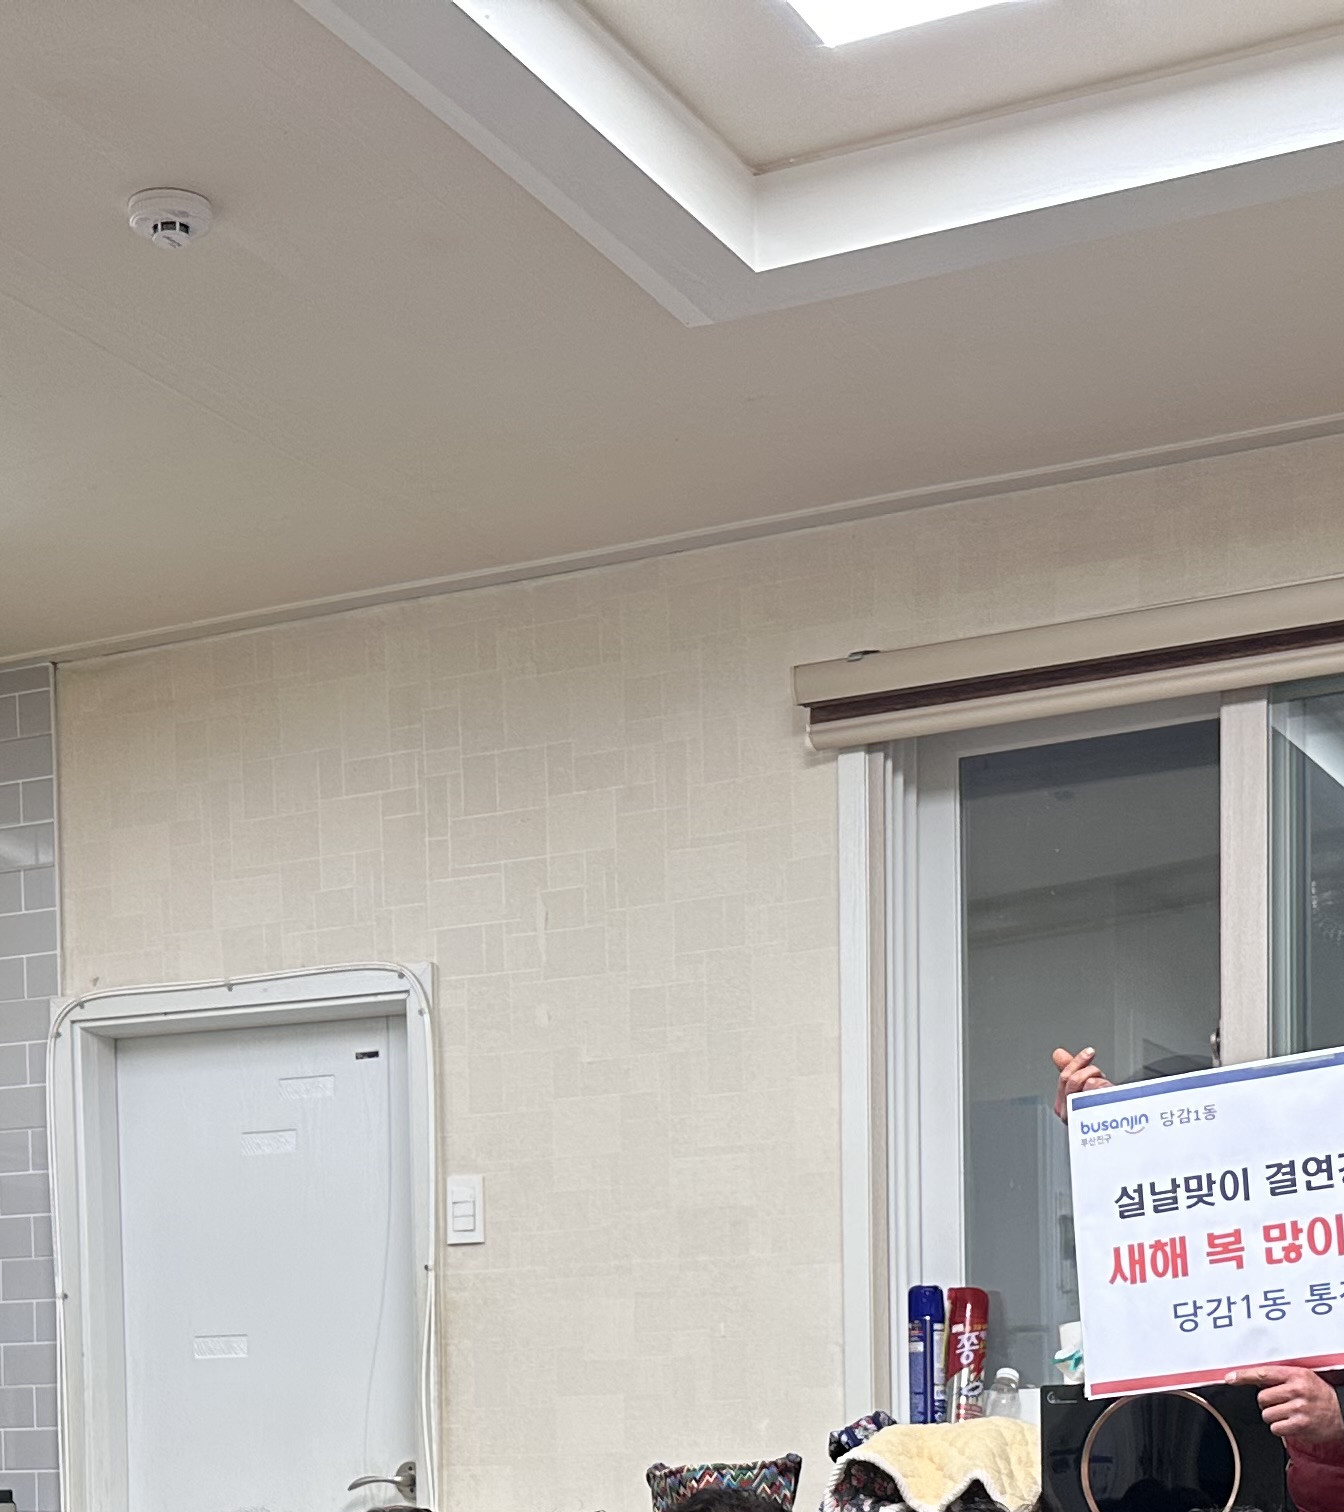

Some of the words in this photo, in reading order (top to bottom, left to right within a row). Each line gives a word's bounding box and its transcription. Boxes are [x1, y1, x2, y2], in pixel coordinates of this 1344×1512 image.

[1080, 1113, 1149, 1135] busanjin
[1160, 1103, 1218, 1127] 당감1동
[1080, 1133, 1112, 1148] 부산진구
[1114, 1166, 1251, 1220] 설날맞이
[1108, 1235, 1189, 1286] 새해
[1205, 1227, 1246, 1271] 복
[1172, 1287, 1292, 1334] 당감1동
